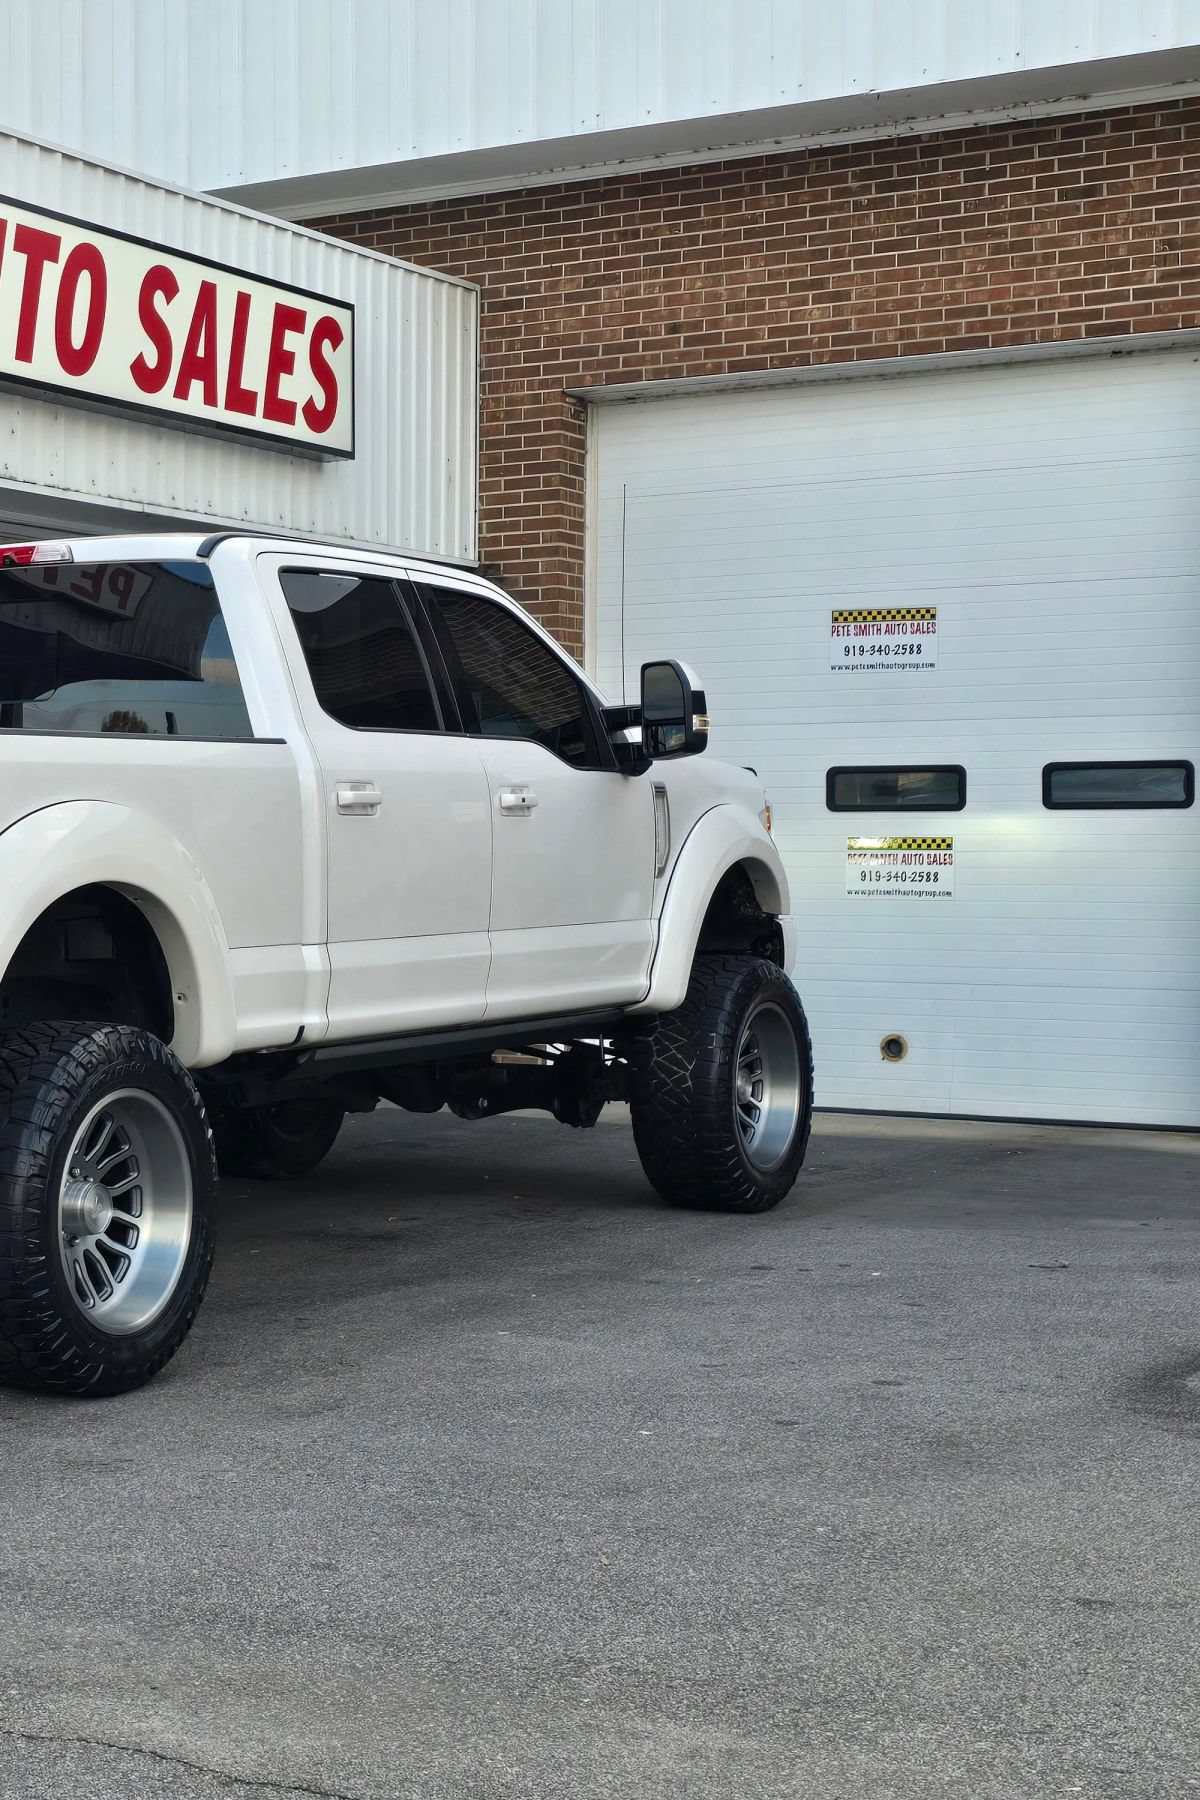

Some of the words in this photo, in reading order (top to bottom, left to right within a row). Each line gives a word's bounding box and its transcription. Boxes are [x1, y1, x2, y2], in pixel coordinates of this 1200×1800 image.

[131, 265, 343, 433] SALES
[832, 624, 851, 637] PETE
[853, 623, 882, 637] SMITH
[884, 623, 908, 636] AUTO
[910, 622, 936, 635] SALES
[844, 643, 922, 657] 919-340-2588
[830, 661, 936, 672] www.petesmithautogroup.com
[901, 853, 924, 866] AUTO
[927, 853, 953, 866] SALES
[860, 870, 939, 883] 919-340-2588
